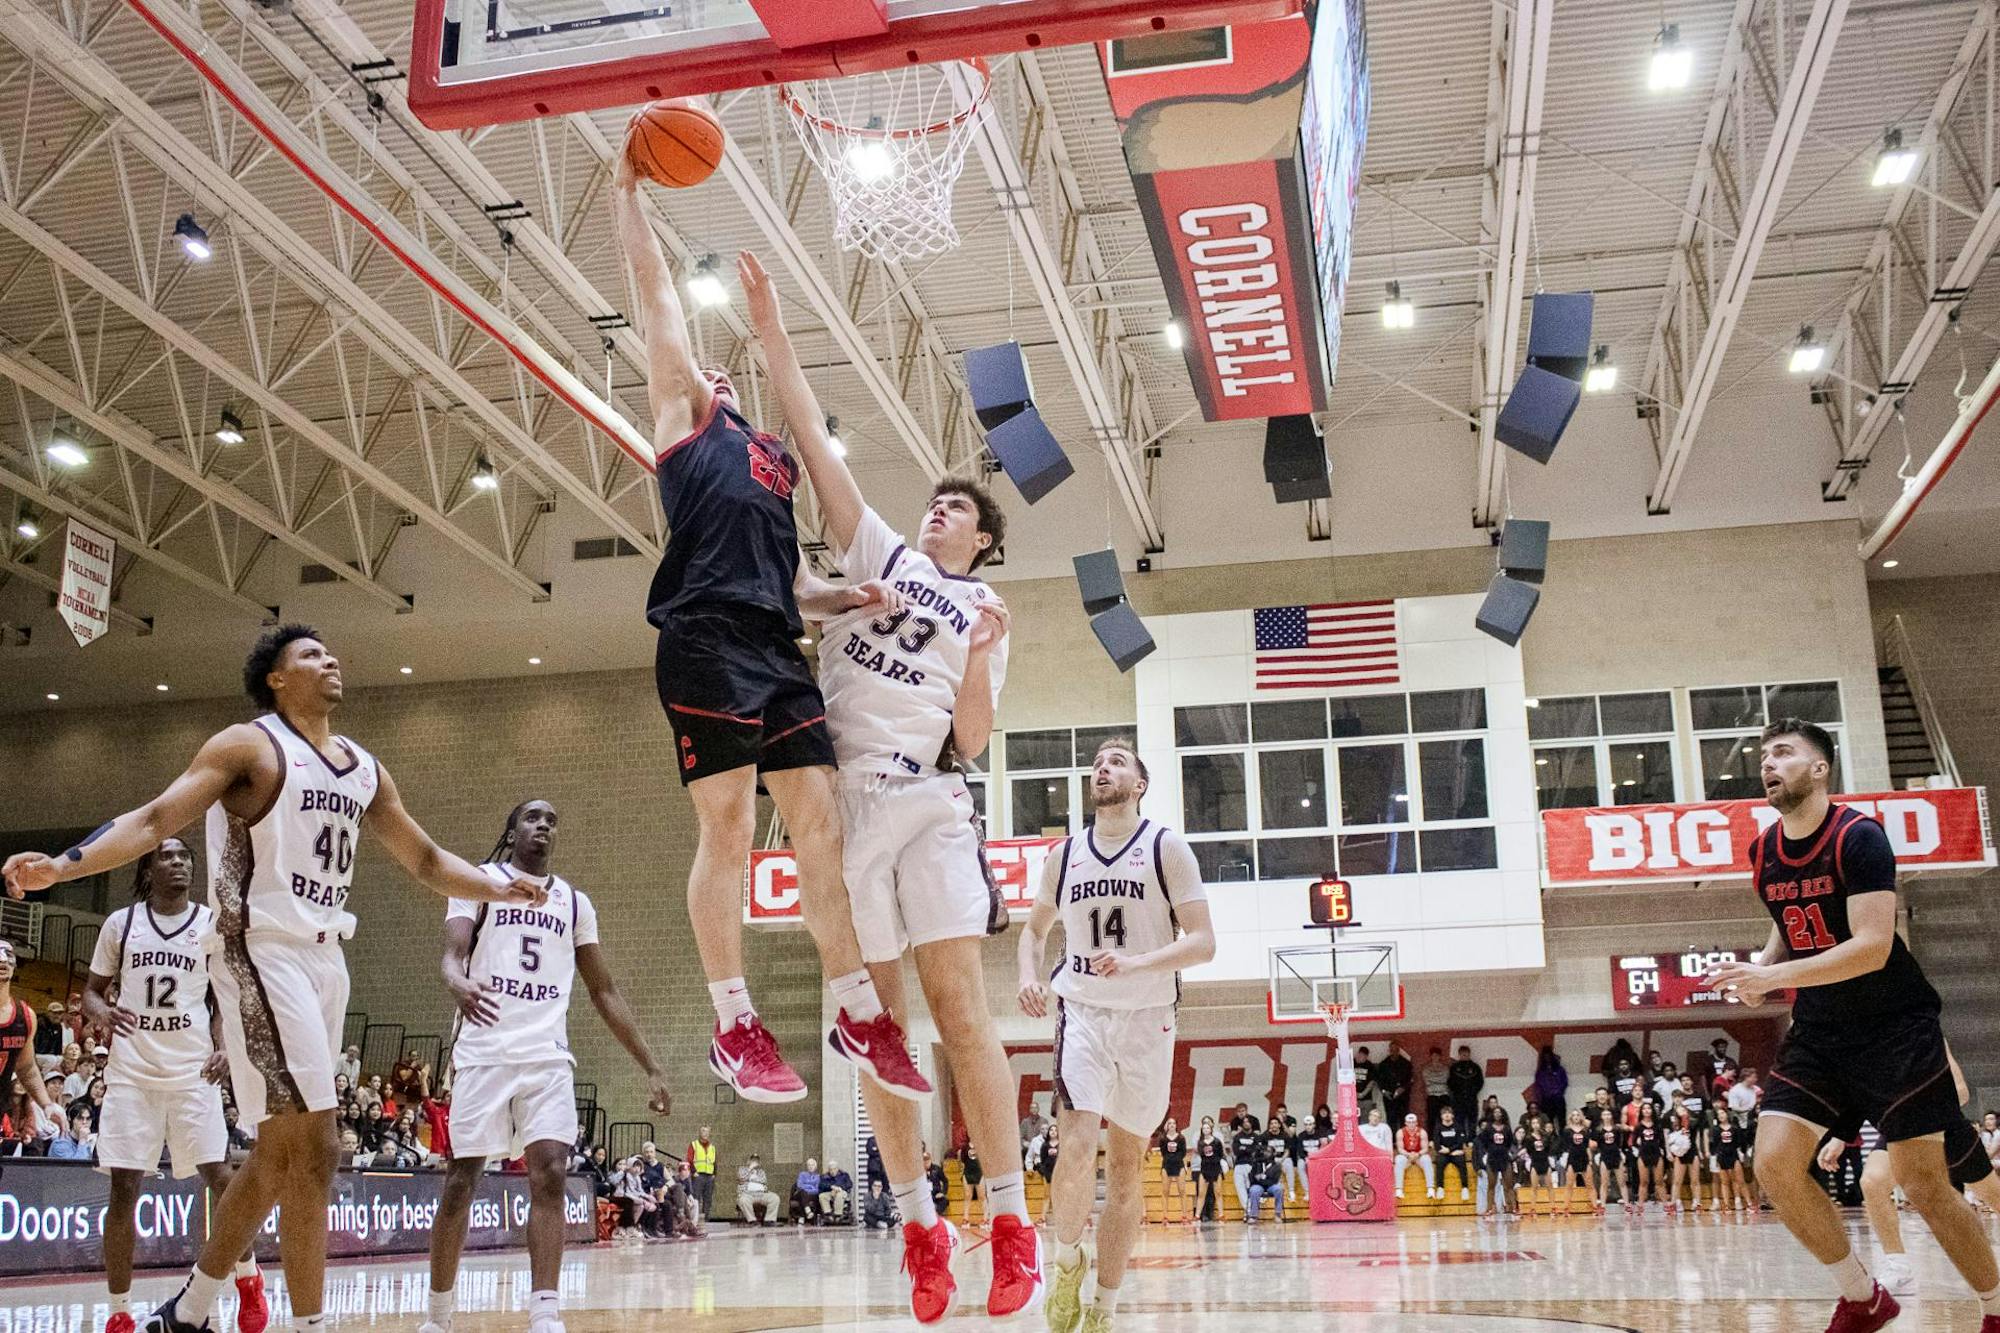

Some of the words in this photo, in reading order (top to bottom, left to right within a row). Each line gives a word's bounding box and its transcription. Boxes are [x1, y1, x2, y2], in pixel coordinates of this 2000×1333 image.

[1179, 203, 1295, 397] CORNELL
[70, 532, 110, 563] CORNELL
[68, 559, 108, 587] VOLLEYBALL
[869, 605, 939, 656] 33
[843, 632, 926, 686] BEARS
[312, 822, 352, 876] 40
[1585, 810, 1733, 871] BIG
[1070, 880, 1145, 904] BROWN
[1331, 894, 1348, 921] 6
[1766, 881, 1798, 901] BIG
[495, 907, 567, 939] BROWN
[1088, 905, 1127, 949] 14
[1783, 903, 1837, 951] 21
[132, 951, 196, 972] BROWN
[519, 933, 542, 976] 5
[145, 973, 177, 1009] 12
[491, 975, 560, 1001] BEARS
[1628, 970, 1660, 994] 64
[139, 1013, 192, 1032] EARS
[0, 1193, 90, 1241] Doors
[134, 1194, 194, 1237] CNY
[371, 1195, 398, 1231] for
